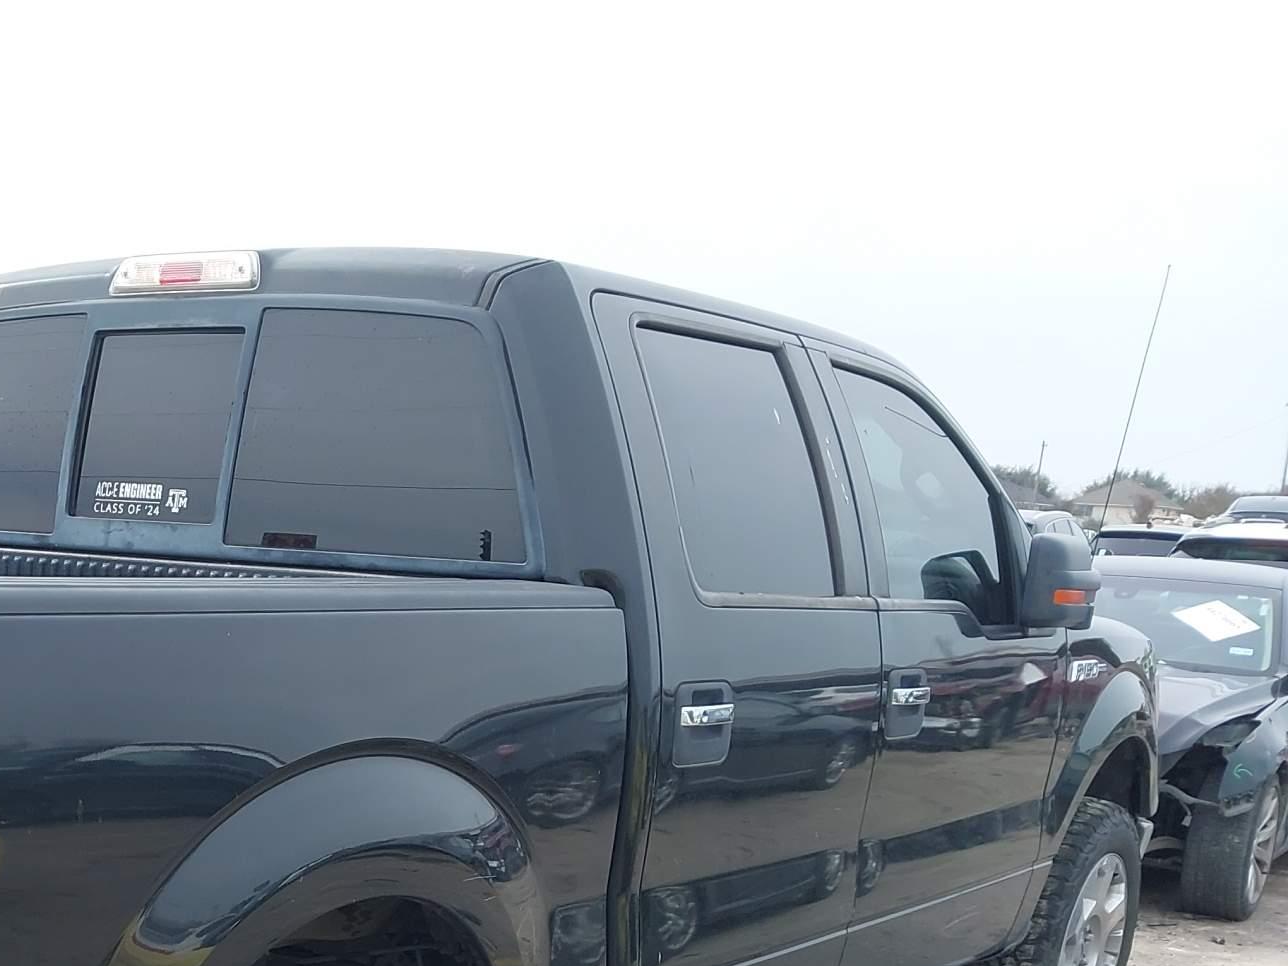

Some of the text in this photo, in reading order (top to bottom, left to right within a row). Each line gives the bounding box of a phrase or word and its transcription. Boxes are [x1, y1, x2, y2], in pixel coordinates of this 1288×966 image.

[119, 482, 163, 500] ENGINEER
[94, 502, 160, 516] CLASS OF '24
